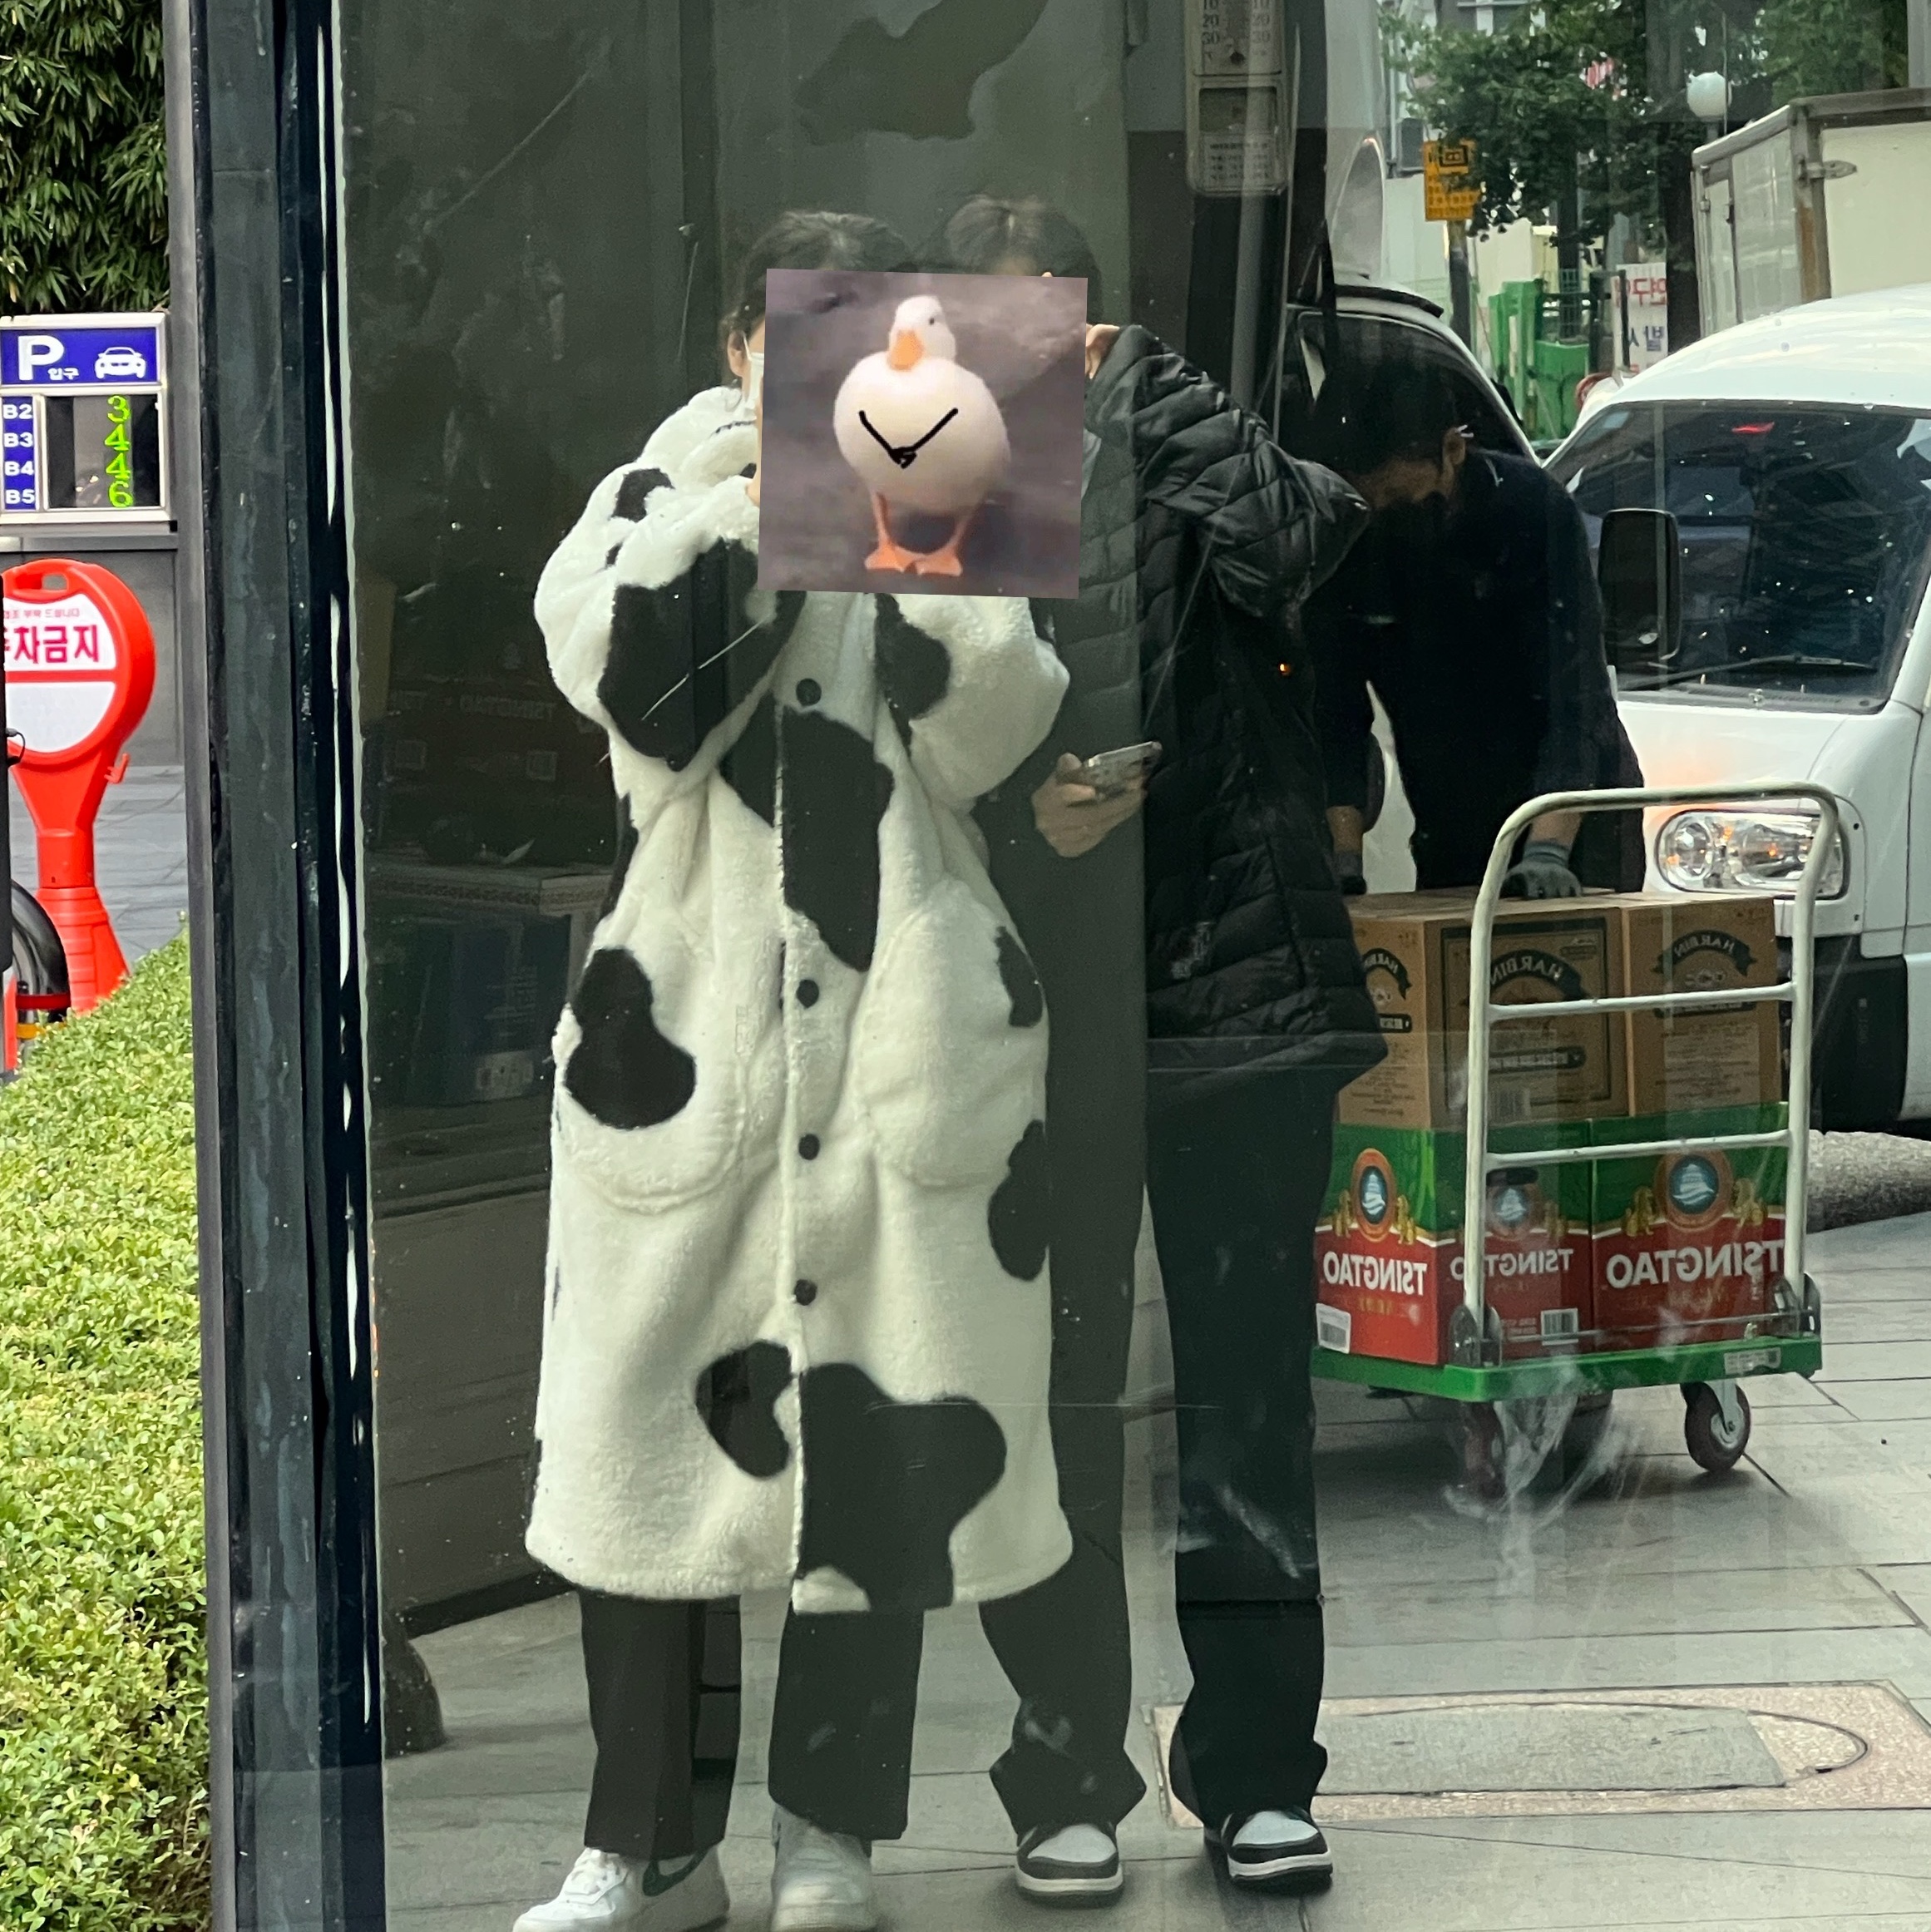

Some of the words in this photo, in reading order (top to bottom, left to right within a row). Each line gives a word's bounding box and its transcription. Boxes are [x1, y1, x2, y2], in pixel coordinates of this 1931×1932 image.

[17, 335, 64, 380] P
[47, 367, 79, 380] 입구
[2, 404, 32, 419] B2
[107, 395, 131, 423] 3
[3, 432, 33, 447] B3
[105, 423, 130, 451] 4
[4, 461, 34, 476] B4
[106, 452, 131, 479] 4
[5, 489, 35, 504] B5
[107, 480, 134, 508] 6
[4, 625, 99, 665] 자금지
